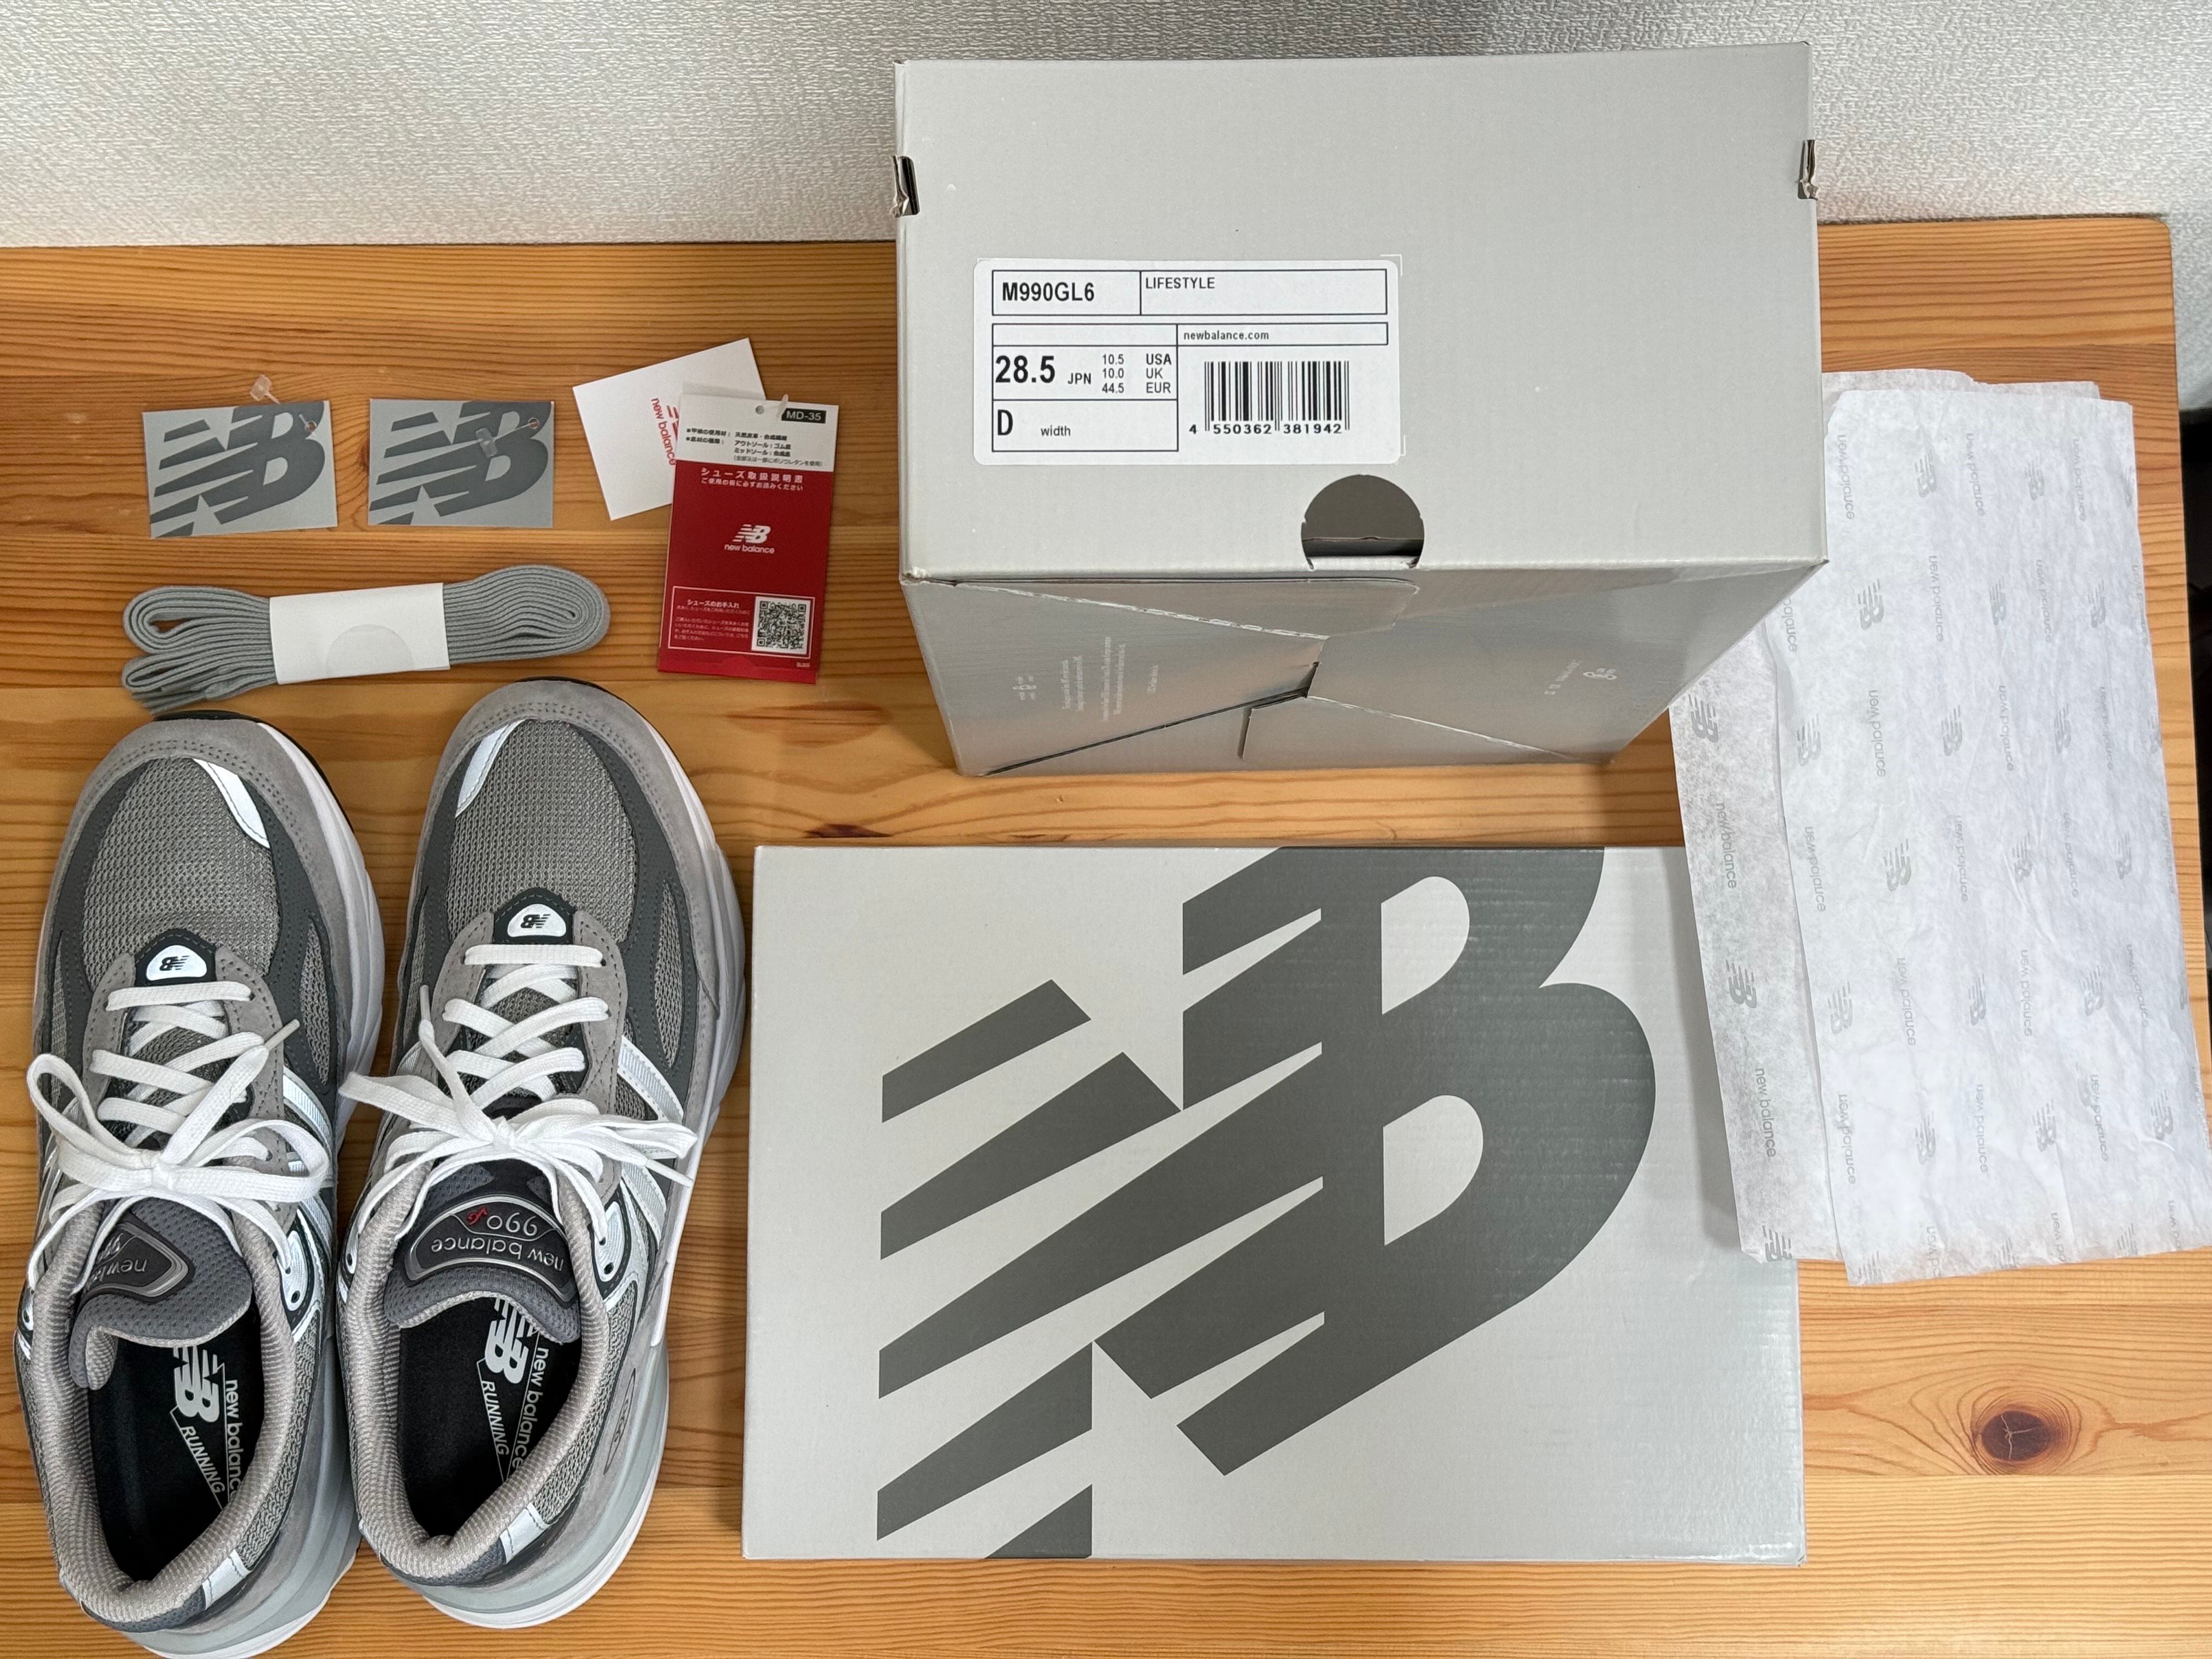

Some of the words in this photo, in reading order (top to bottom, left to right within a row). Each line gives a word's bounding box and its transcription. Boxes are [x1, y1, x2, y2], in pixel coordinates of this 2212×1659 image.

[1002, 281, 1094, 302] M990GL6
[1145, 276, 1216, 289] LIFESTYLE
[1183, 329, 1269, 341] newbalance.com
[995, 355, 1056, 383] 28.5
[1067, 373, 1092, 385] JPN
[1102, 353, 1125, 365] 10.5
[1146, 353, 1172, 365] USA
[1102, 368, 1125, 379] 10.0
[1146, 368, 1164, 379] UK
[1102, 382, 1125, 394] 44.5
[1146, 382, 1171, 394] EUR
[786, 410, 822, 421] MD-35
[997, 409, 1013, 436] D
[1041, 425, 1071, 437] width
[650, 398, 665, 420] new
[658, 420, 677, 465] balance
[1189, 424, 1198, 435] 4
[1212, 424, 1272, 434] 550362
[1283, 423, 1342, 434] 381942
[742, 544, 775, 554] balance
[1754, 1068, 1768, 1096] new
[1759, 1099, 1776, 1157] balance
[486, 1212, 538, 1236] 990
[431, 1237, 522, 1260] balance
[527, 1248, 563, 1271] new
[531, 1347, 549, 1387] new
[225, 1379, 239, 1419] new
[481, 1380, 510, 1455] RUNNING
[512, 1390, 543, 1469] balance
[180, 1426, 225, 1493] RUNNING
